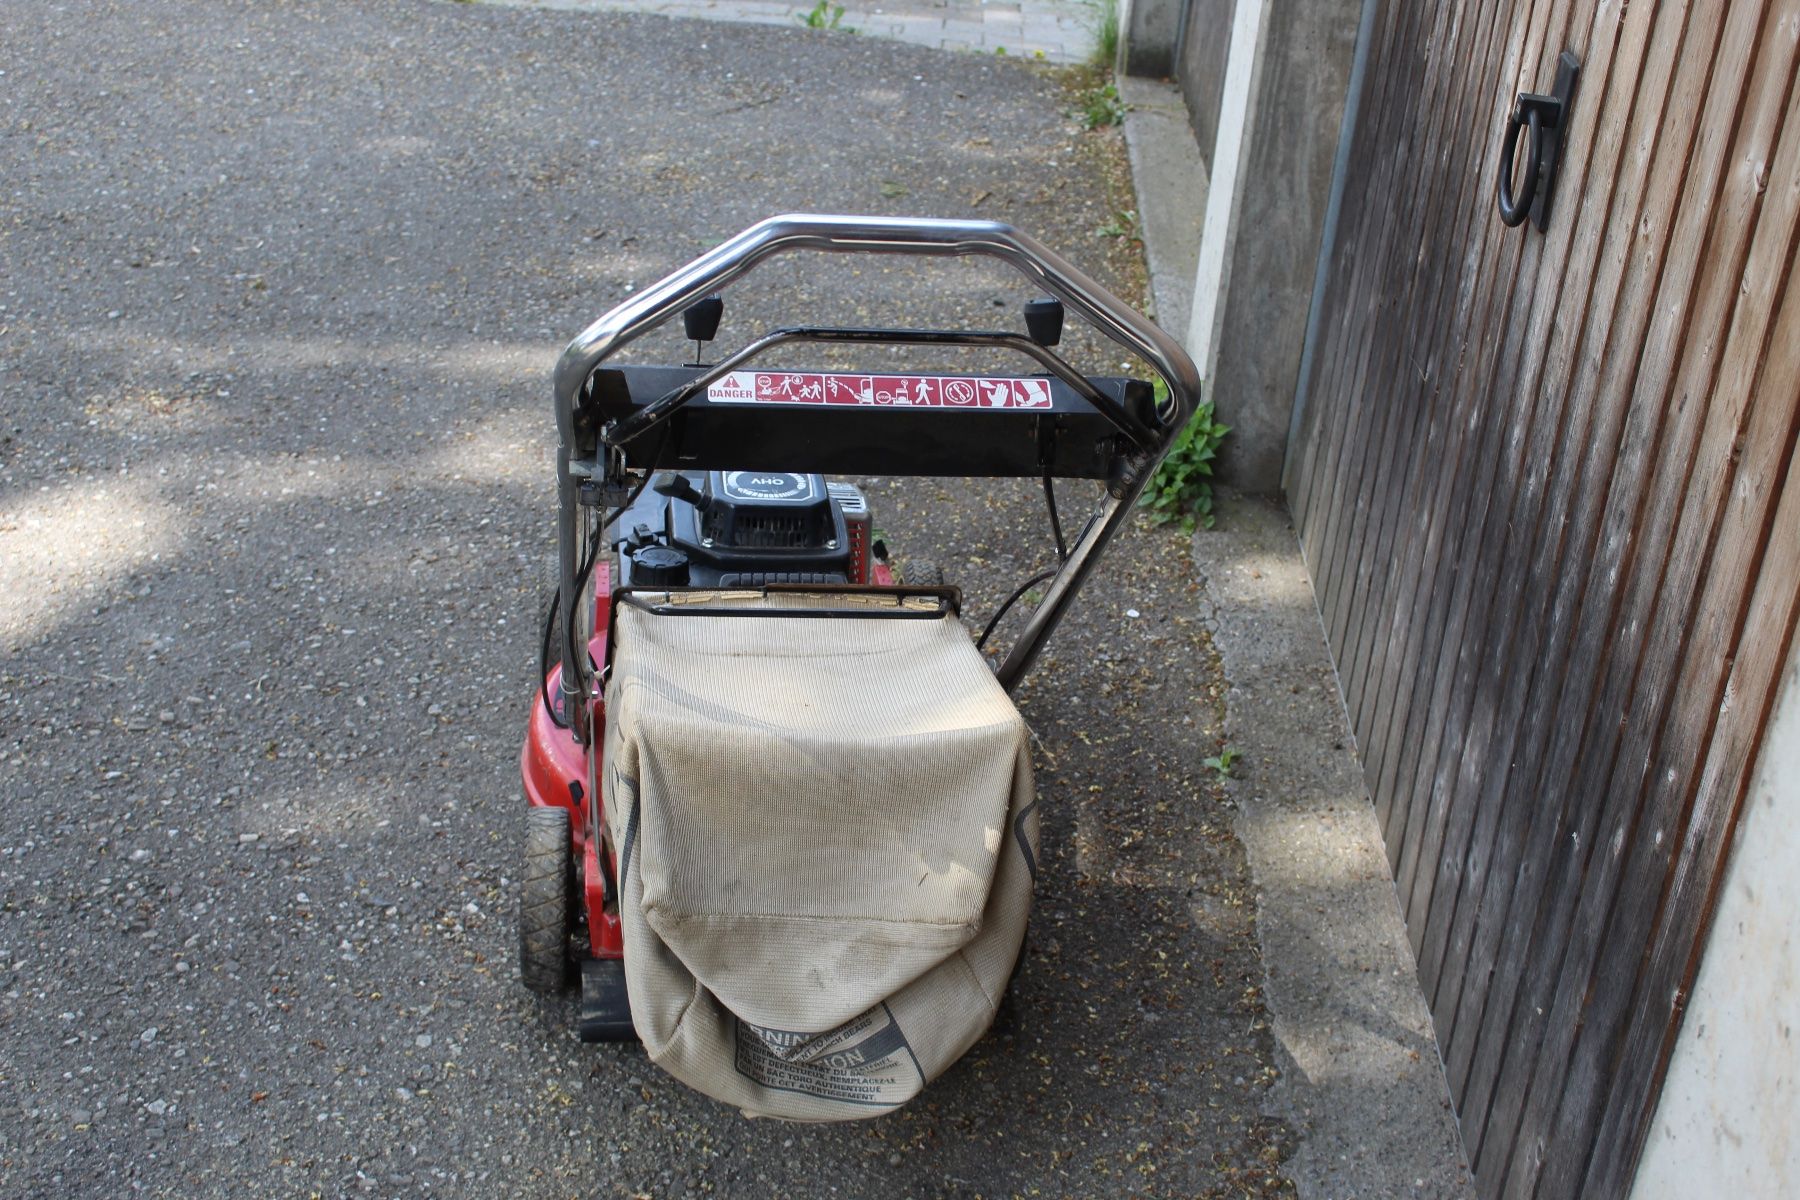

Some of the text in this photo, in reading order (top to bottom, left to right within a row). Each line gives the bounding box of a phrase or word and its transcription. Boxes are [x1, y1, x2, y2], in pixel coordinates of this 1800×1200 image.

[709, 389, 753, 399] DANGER
[750, 477, 784, 485] OHV
[843, 1018, 872, 1039] BEARS
[754, 1061, 764, 1073] UN
[767, 1068, 785, 1078] SAC
[788, 1073, 813, 1083] TORO
[815, 1080, 881, 1093] AUTHENTIQUE
